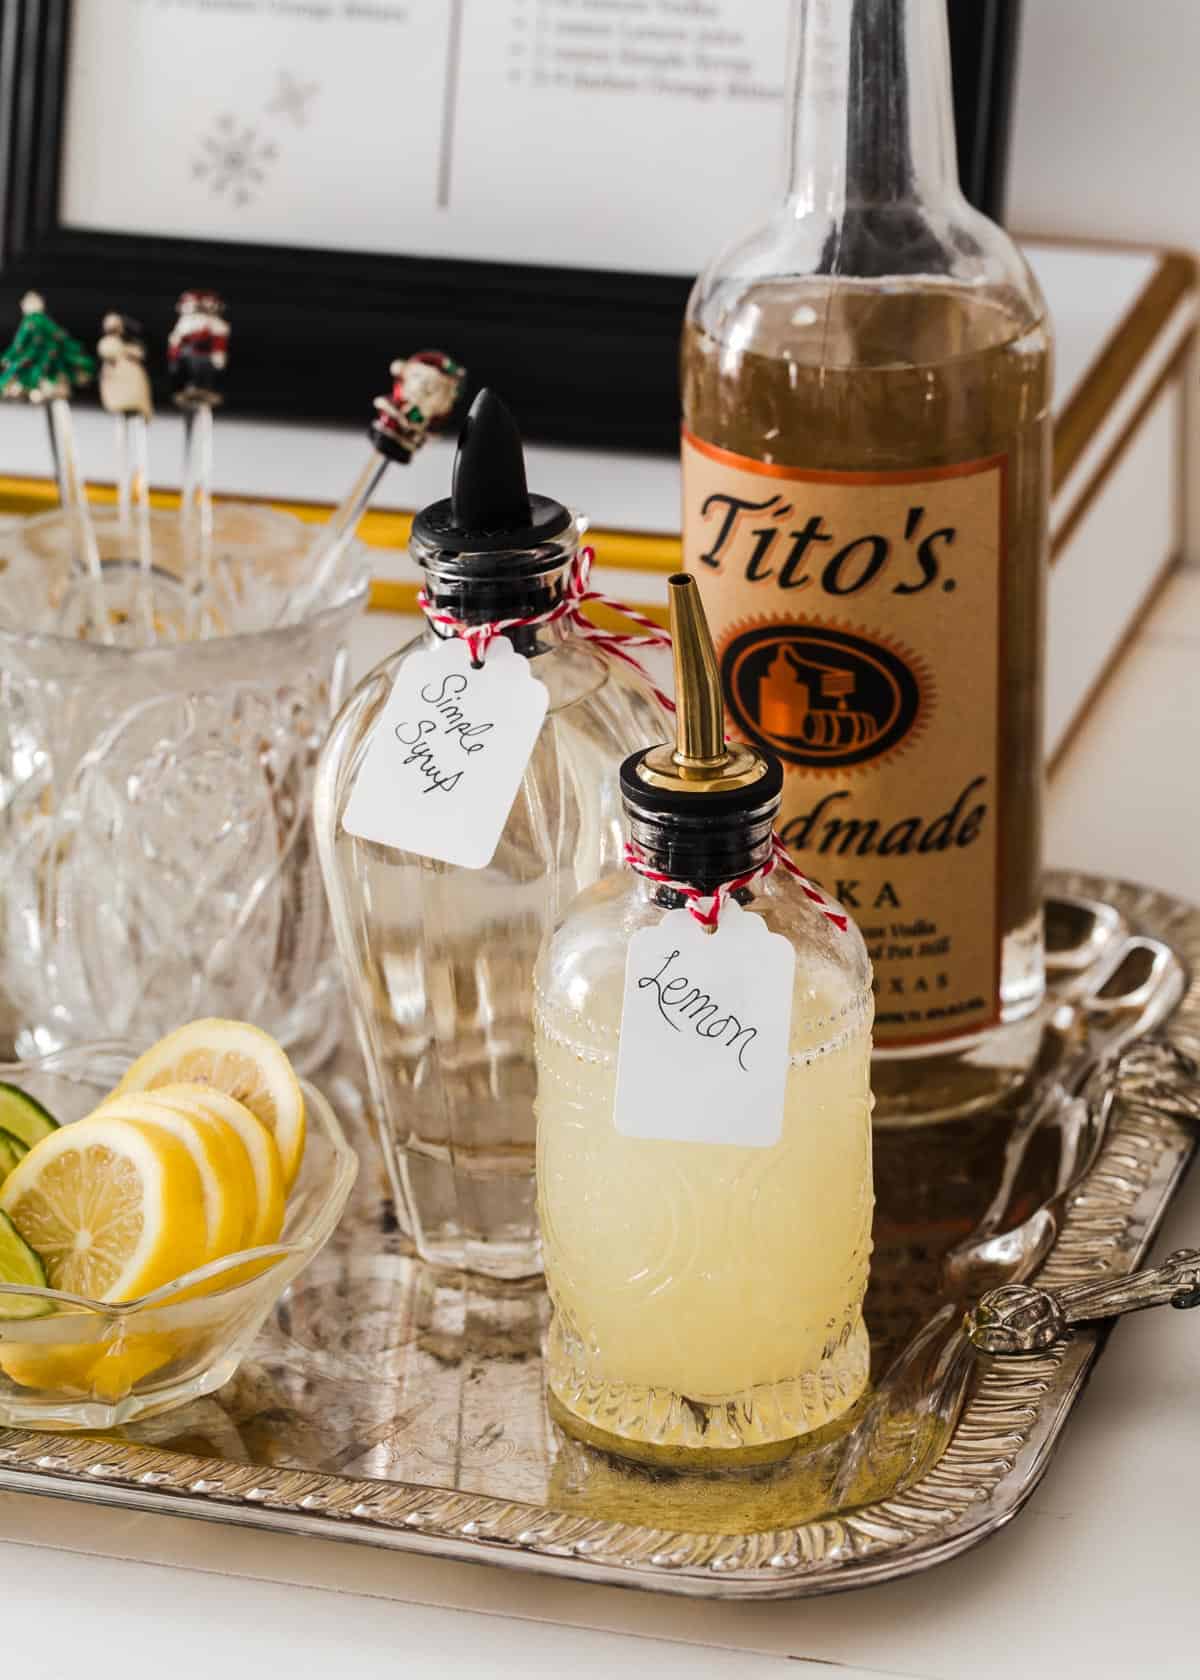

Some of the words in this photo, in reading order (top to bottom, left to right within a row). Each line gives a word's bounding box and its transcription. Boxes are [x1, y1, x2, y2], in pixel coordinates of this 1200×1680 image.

[420, 673, 495, 756] Simple
[394, 719, 465, 794] Syrup
[780, 774, 988, 857] dmade
[637, 949, 758, 1073] Lemon
